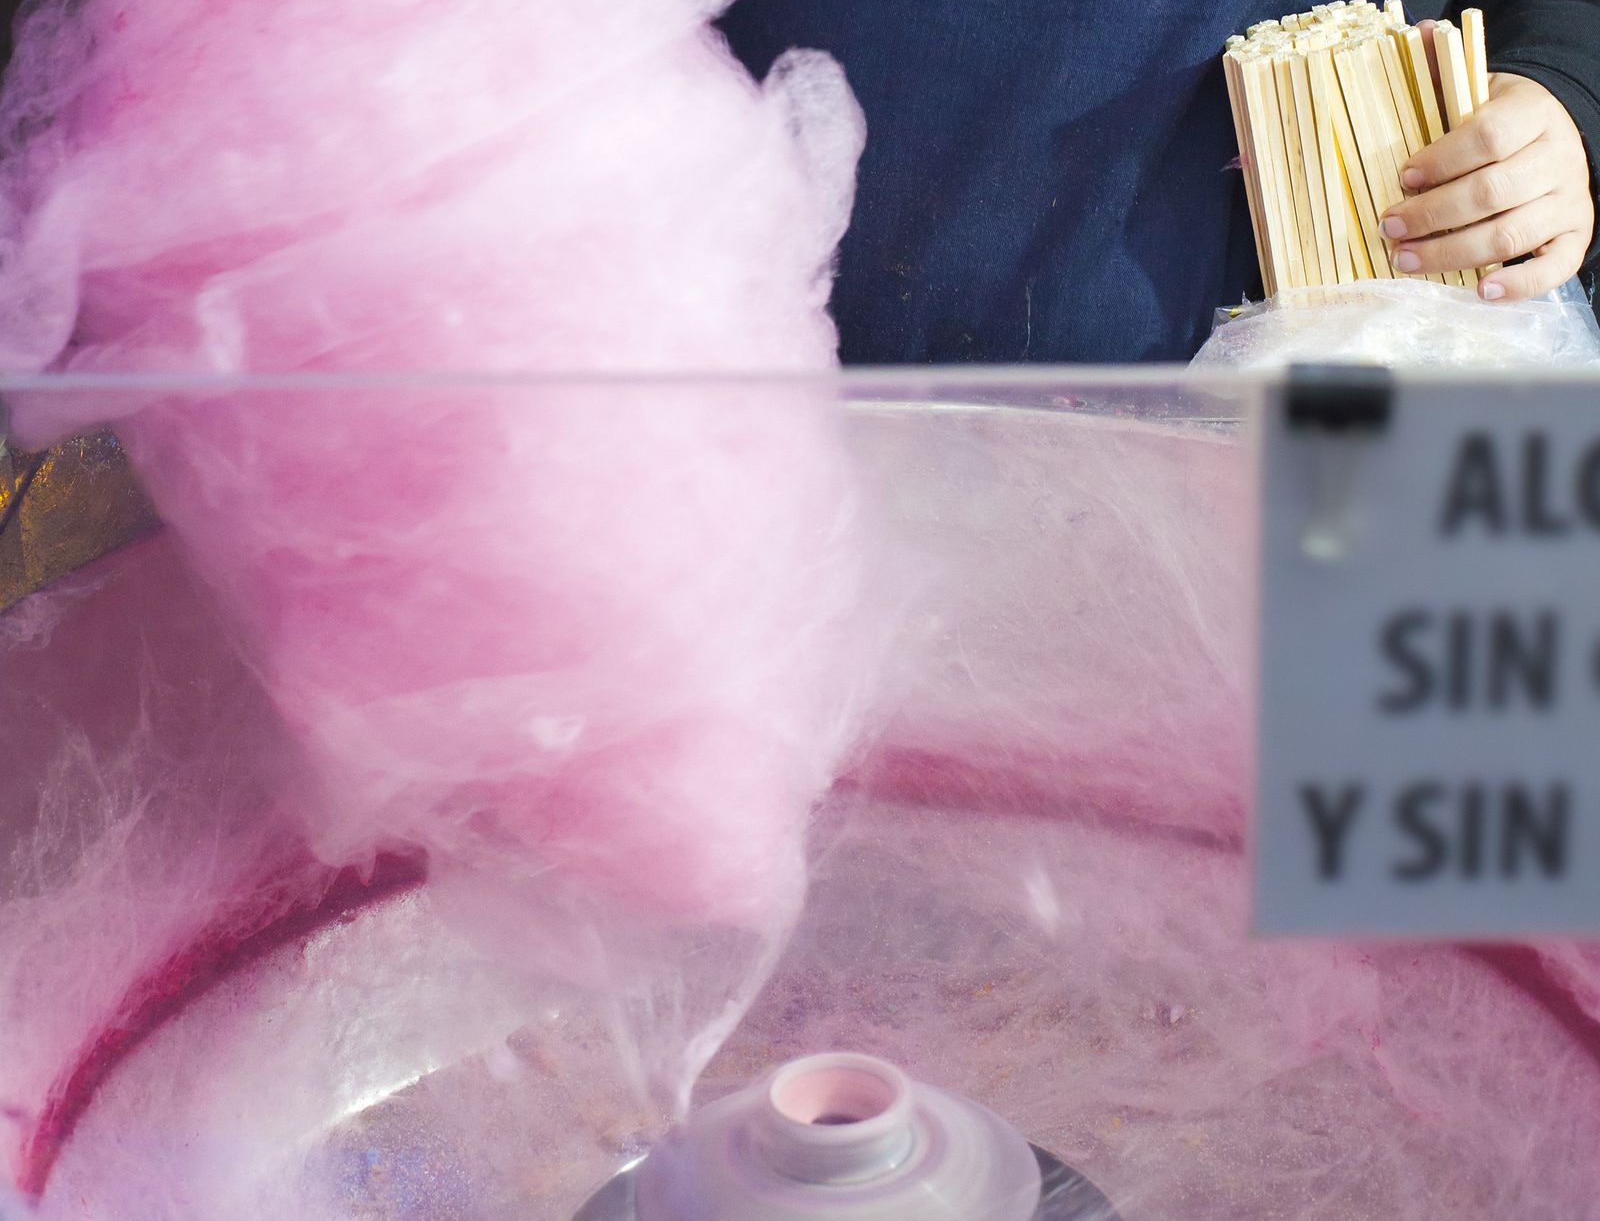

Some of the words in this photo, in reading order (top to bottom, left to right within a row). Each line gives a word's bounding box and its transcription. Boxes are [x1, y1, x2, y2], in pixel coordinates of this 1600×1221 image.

[1377, 610, 1561, 717] SIN
[1300, 781, 1367, 883] Y
[1391, 779, 1570, 884] SIN
